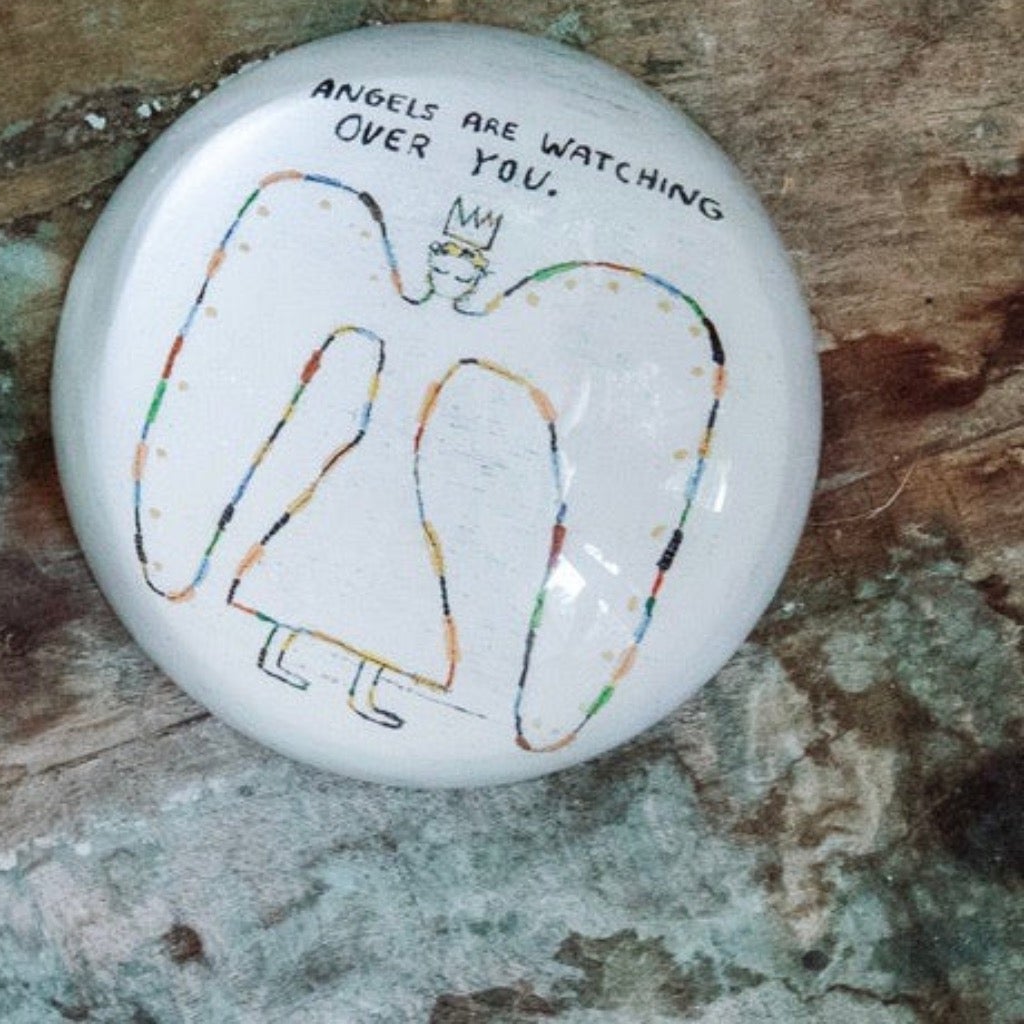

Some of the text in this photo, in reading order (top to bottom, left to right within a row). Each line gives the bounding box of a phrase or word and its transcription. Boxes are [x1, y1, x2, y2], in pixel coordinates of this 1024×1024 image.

[310, 77, 725, 222] ANGELS ARE WATCHING
[334, 113, 558, 198] OVER YOU.
